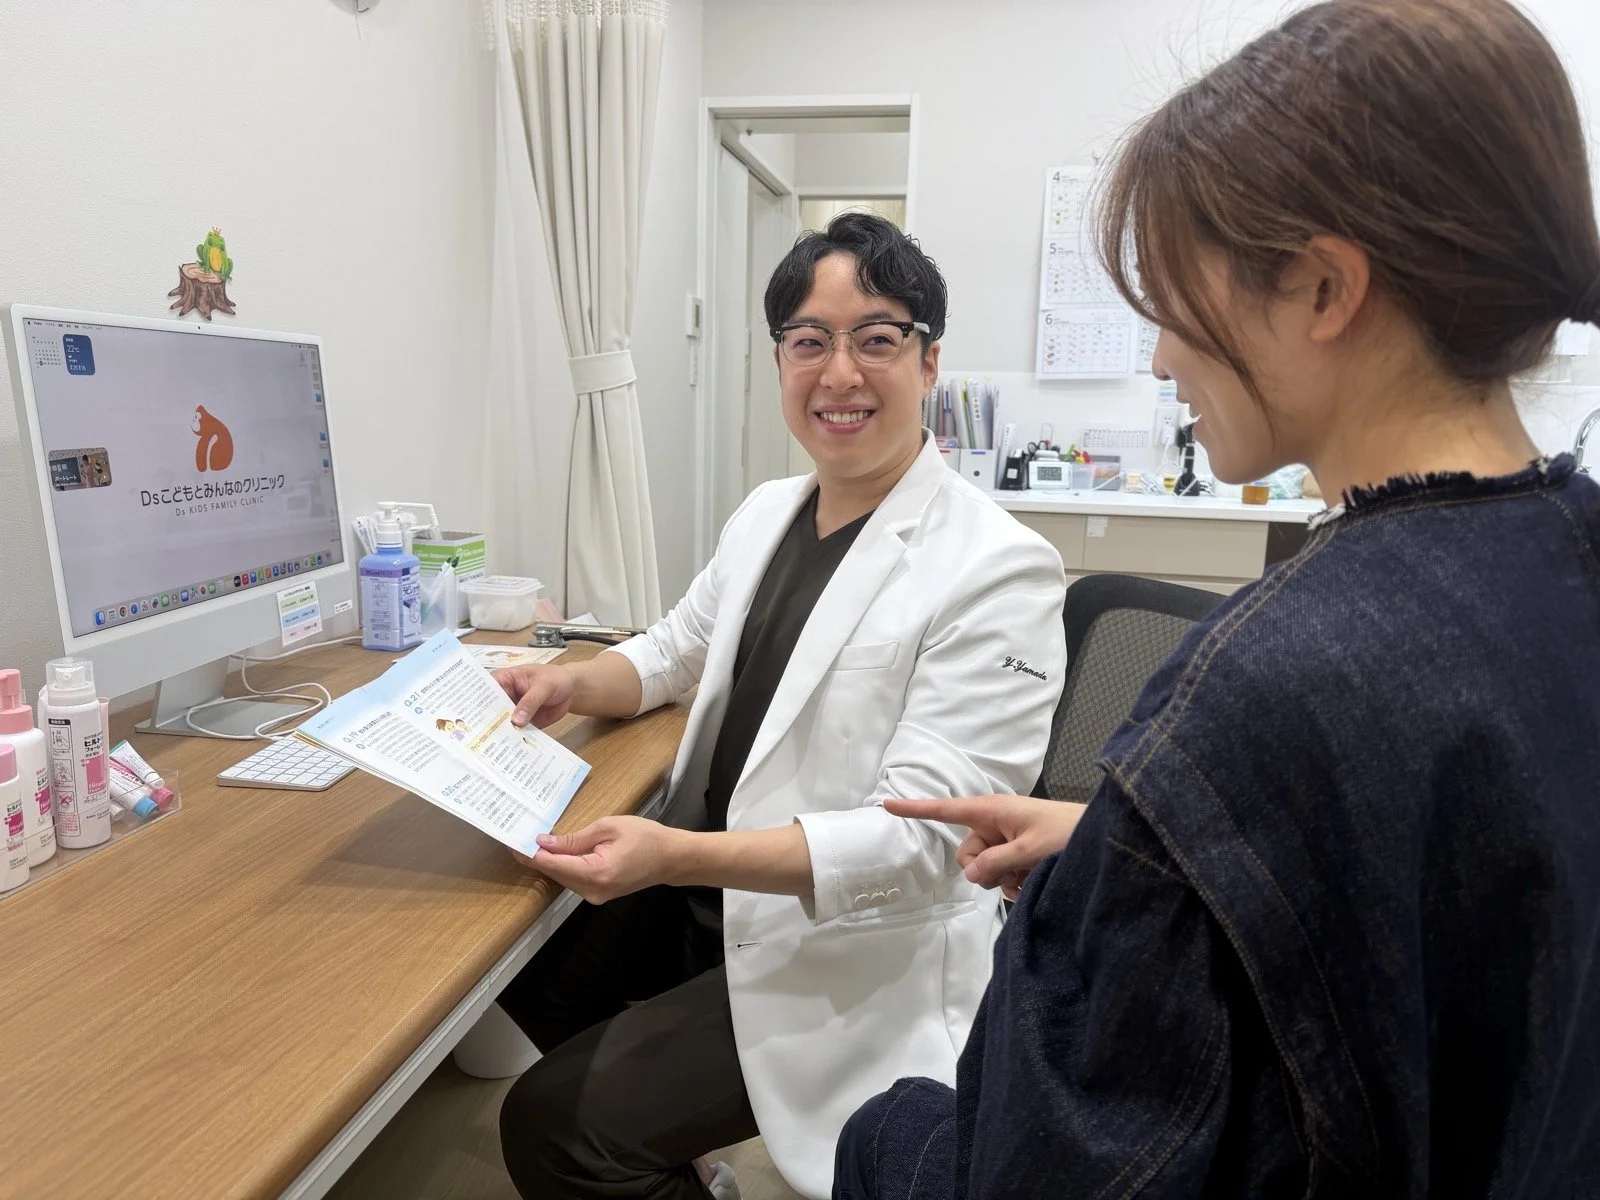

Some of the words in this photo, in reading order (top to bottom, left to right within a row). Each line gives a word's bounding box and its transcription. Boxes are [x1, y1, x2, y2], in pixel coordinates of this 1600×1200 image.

[1053, 171, 1060, 182] 4
[1049, 243, 1057, 254] 5
[1045, 314, 1053, 325] 6
[140, 474, 285, 507] Dsこどもとみんなのクリニック
[175, 507, 186, 517] Ds
[189, 503, 208, 515] KIDS
[211, 499, 237, 511] FAMILY
[241, 495, 264, 506] CLINIC
[1001, 656, 1048, 681] Y.Yamada
[404, 691, 421, 707] Q.21
